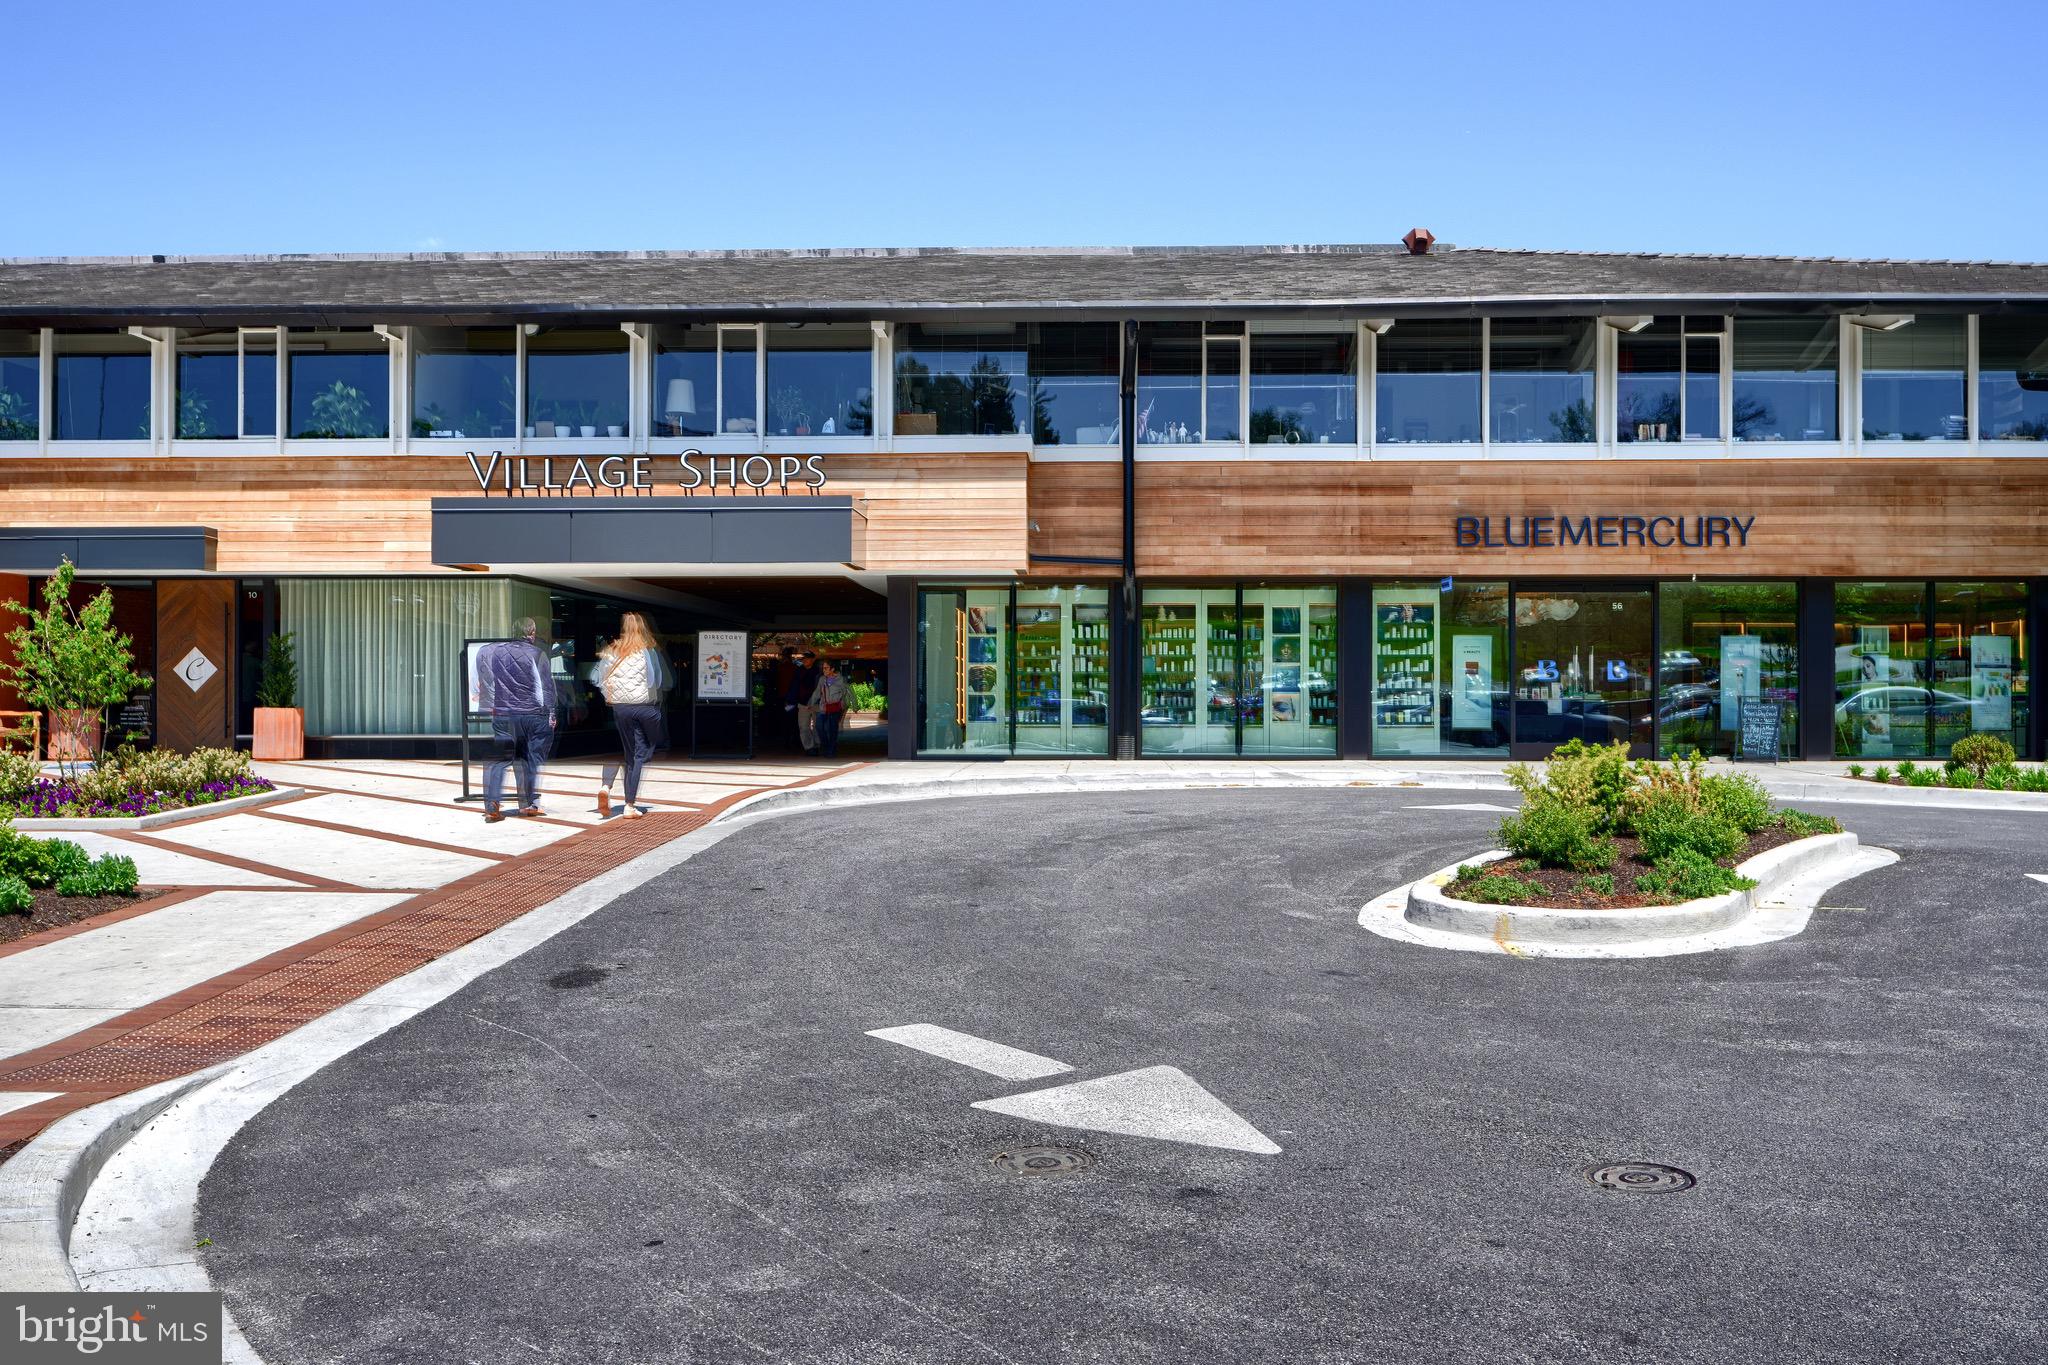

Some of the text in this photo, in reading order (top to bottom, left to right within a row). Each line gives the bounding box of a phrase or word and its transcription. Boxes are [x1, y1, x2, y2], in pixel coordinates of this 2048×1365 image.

[465, 448, 826, 490] VILLAGE SHOPS
[1455, 515, 1756, 548] BLUEMERCURY
[248, 591, 258, 599] 10
[1611, 602, 1623, 610] 56
[185, 656, 205, 682] C
